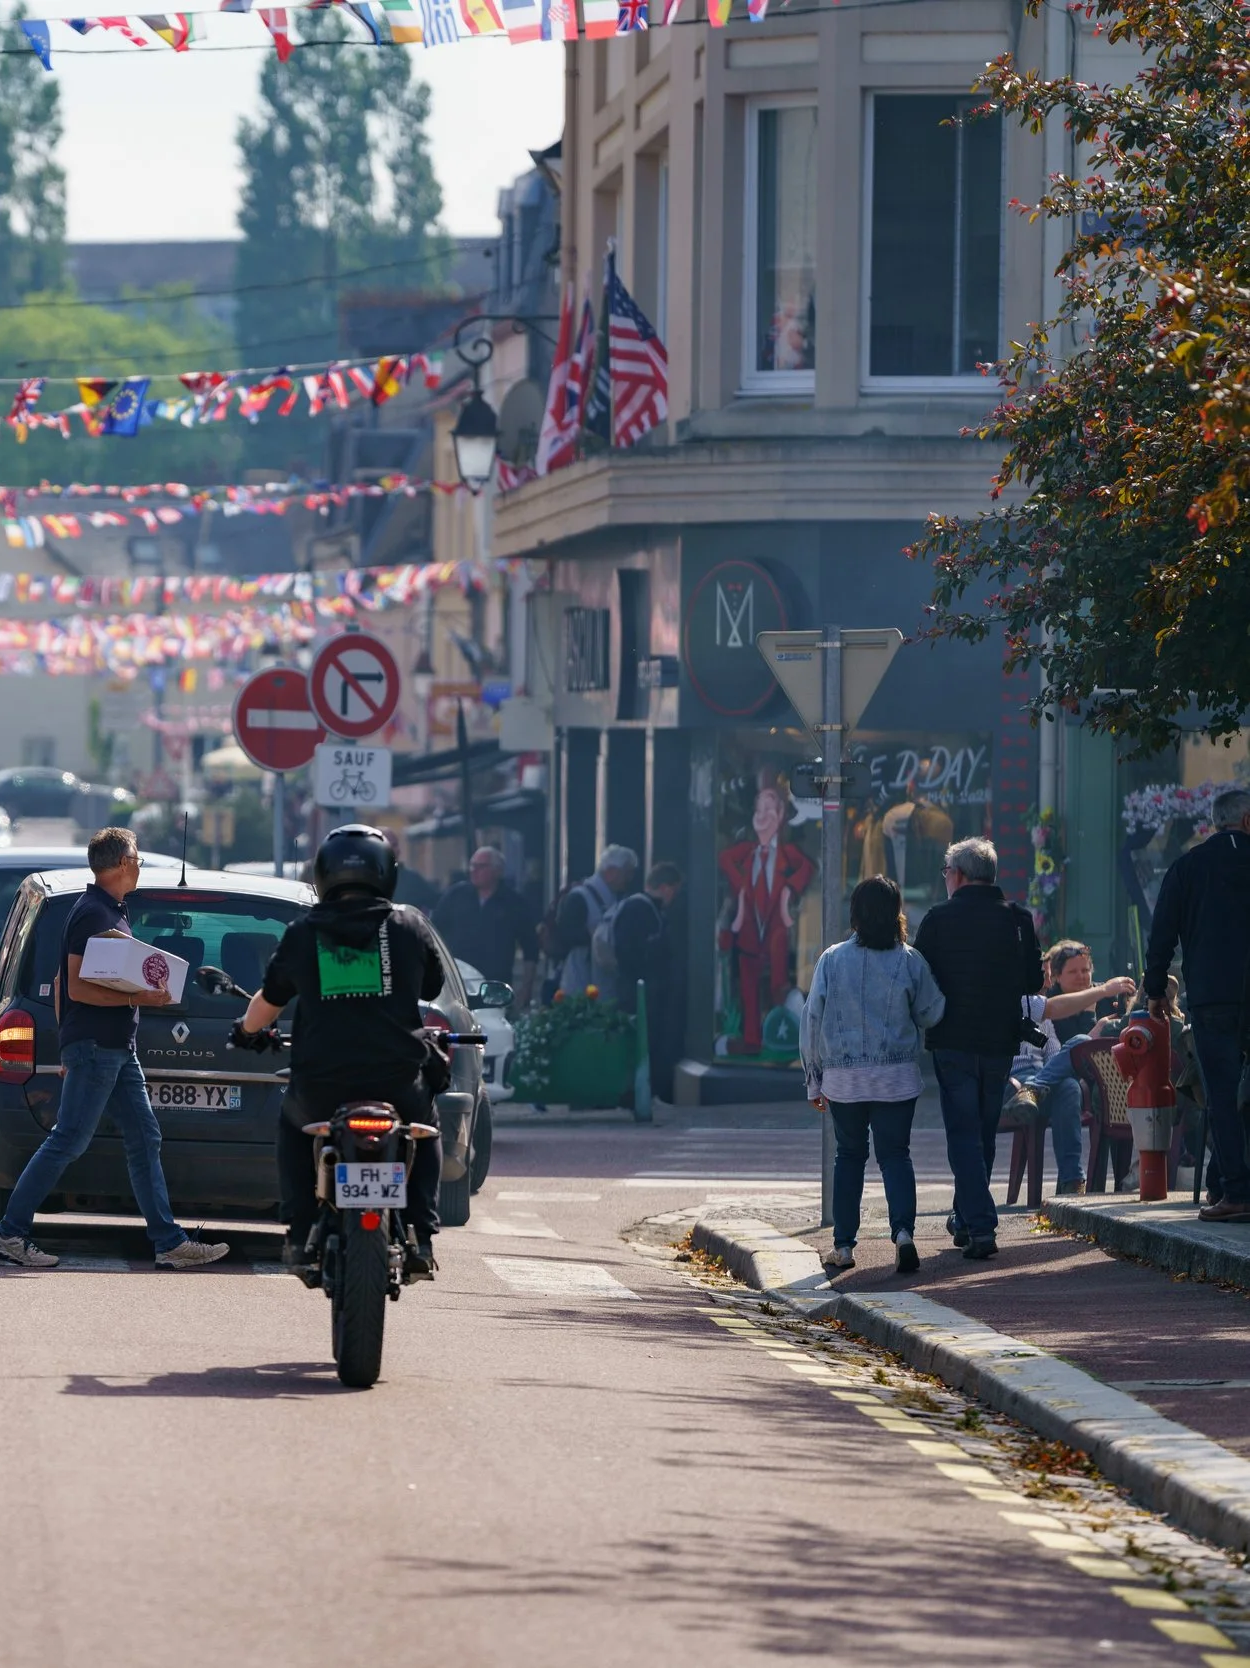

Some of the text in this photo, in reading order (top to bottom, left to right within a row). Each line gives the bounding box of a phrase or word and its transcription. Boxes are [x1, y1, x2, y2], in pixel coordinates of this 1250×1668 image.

[333, 750, 375, 767] SAUF
[380, 939, 391, 974] NORTH
[382, 975, 392, 997] THE
[147, 1049, 215, 1058] MODUS
